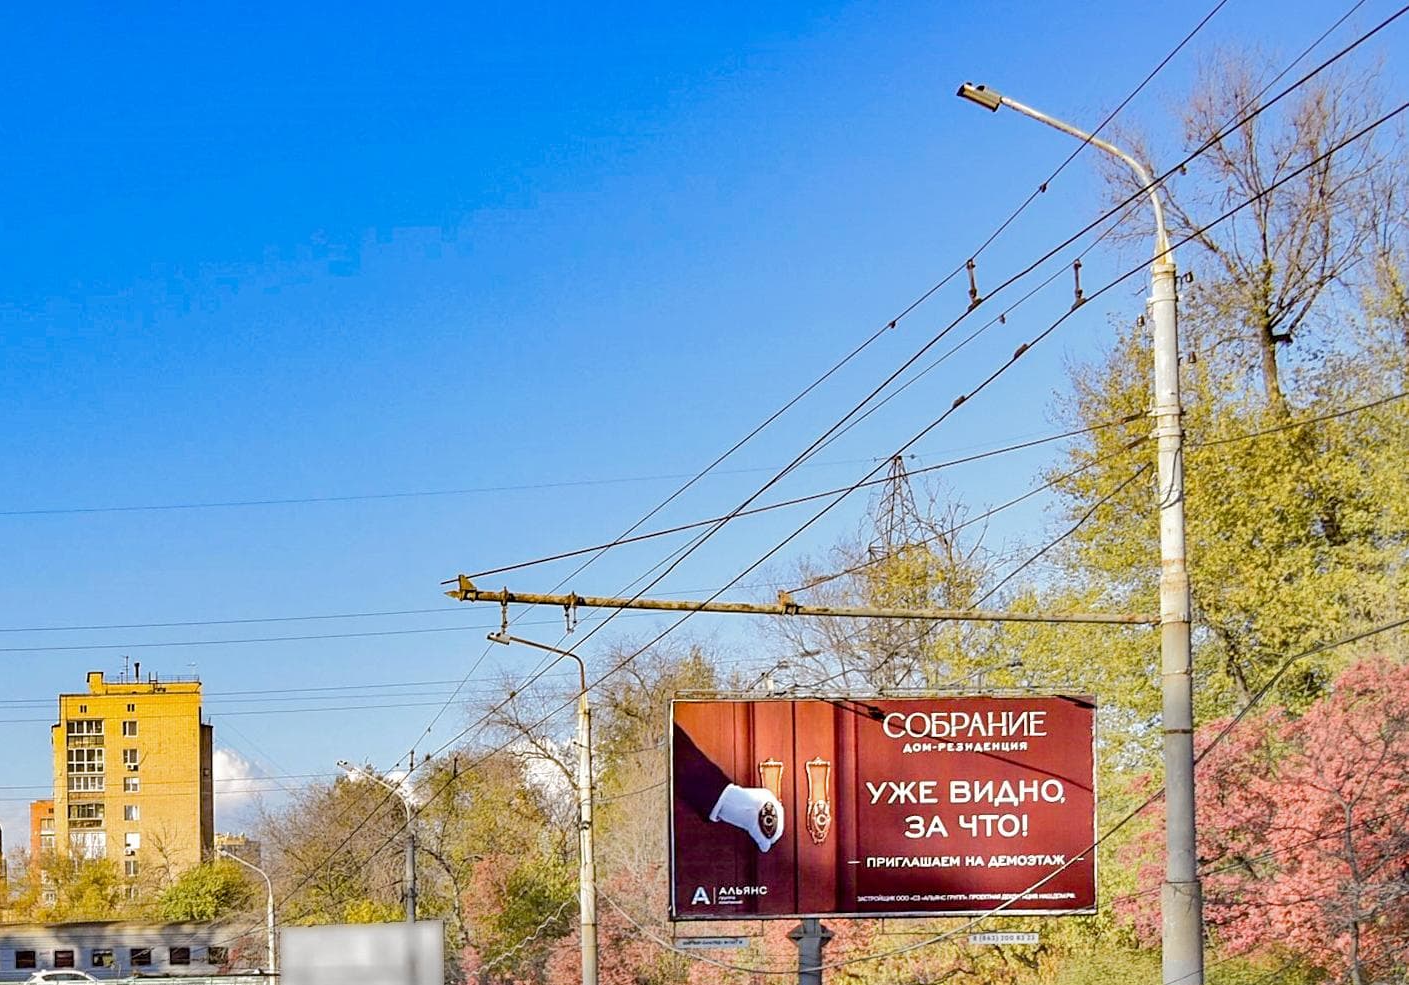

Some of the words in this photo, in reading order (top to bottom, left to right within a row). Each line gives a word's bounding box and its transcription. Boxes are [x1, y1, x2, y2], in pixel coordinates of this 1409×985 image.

[883, 712, 1047, 738] СОБРАНИЕ
[903, 742, 1028, 753] ДОМ-РЕЗИДЕНЦИЯ
[866, 781, 938, 804] УЖЕ
[950, 779, 1065, 807] ВИДНО,
[904, 815, 948, 838] ЗА
[959, 814, 1028, 837] ЧТО!
[866, 856, 960, 868] ПРИГЛАШАЕМ
[965, 856, 984, 866] НА
[988, 854, 1065, 868] ДЕМОЭТАЖ
[718, 886, 768, 895] АЛЬЯНС
